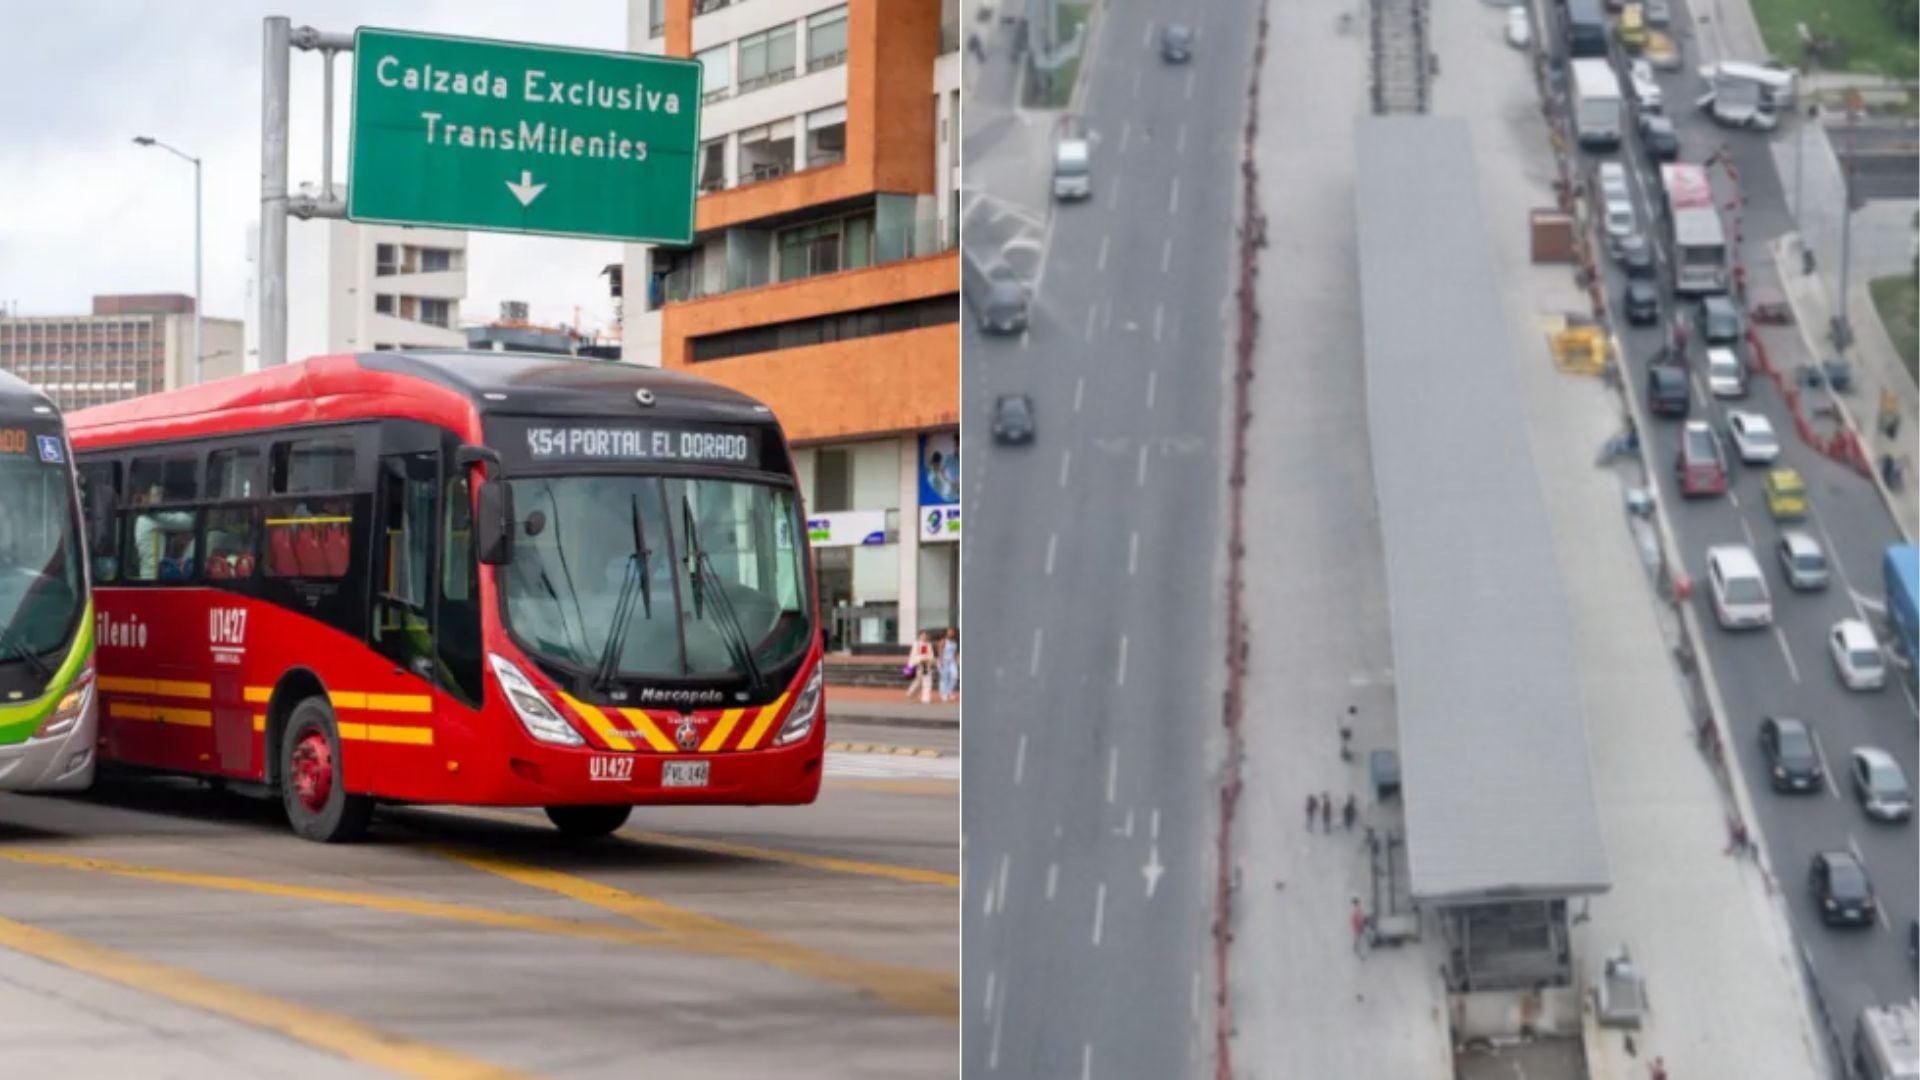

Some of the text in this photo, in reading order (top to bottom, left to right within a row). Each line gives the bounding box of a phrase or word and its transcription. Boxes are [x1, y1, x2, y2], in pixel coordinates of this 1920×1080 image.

[376, 56, 680, 114] Calzada Exclusiva
[569, 428, 647, 458] PORTAL
[652, 431, 676, 458] EL
[680, 433, 748, 461] DORADO
[97, 612, 147, 648] ilenio
[209, 607, 248, 644] U1427
[641, 688, 723, 702] Marcopolo
[589, 756, 635, 778] U1427
